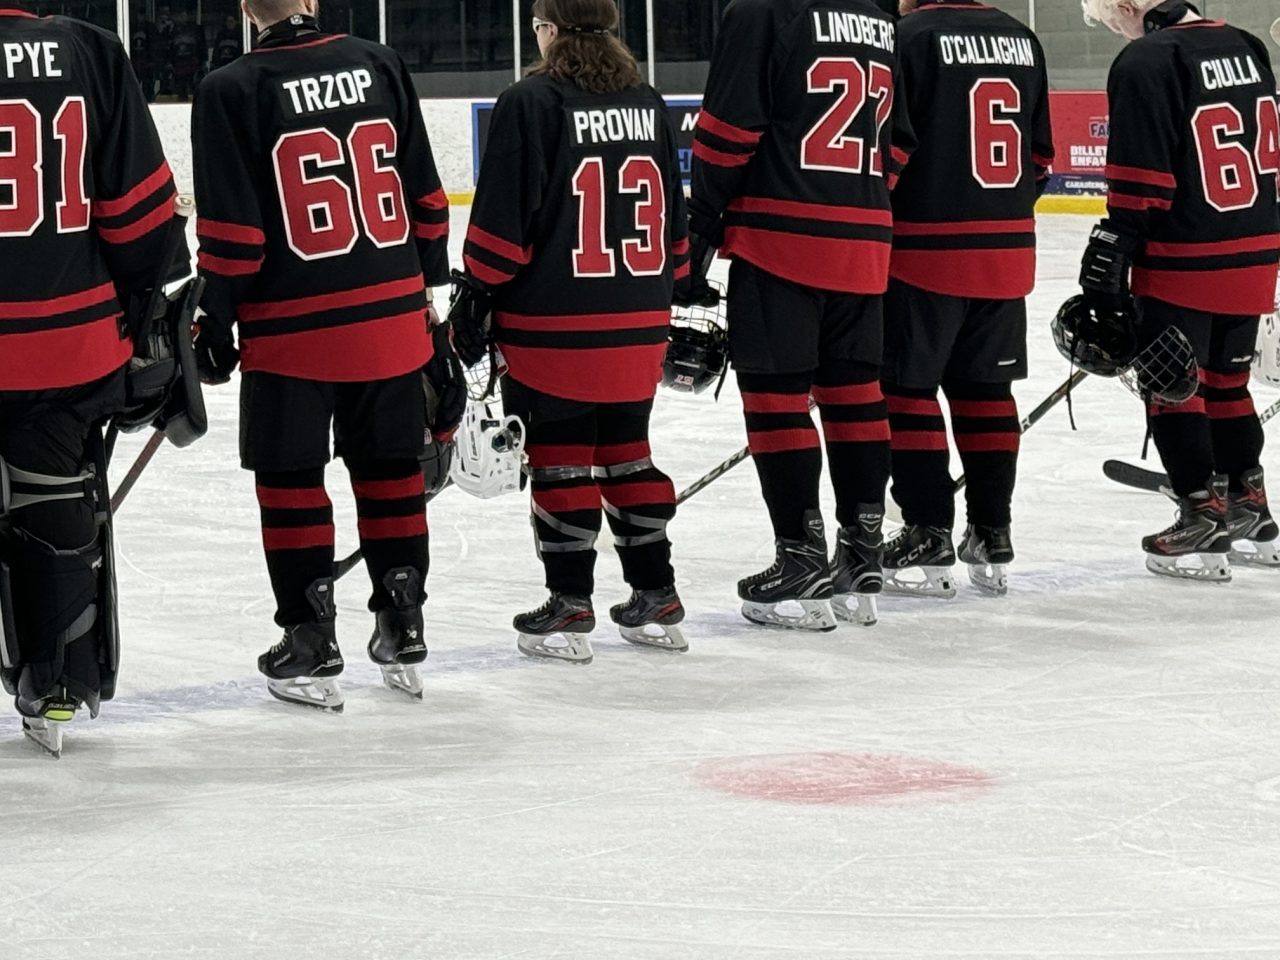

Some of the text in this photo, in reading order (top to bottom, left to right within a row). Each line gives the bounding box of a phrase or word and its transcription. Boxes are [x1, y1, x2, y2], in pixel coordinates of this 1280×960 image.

[2, 40, 63, 79] PYE
[940, 34, 1035, 68] O'CALLAGHAN
[1200, 54, 1262, 90] CIULLA
[282, 68, 373, 115] TRZOP
[573, 108, 655, 144] PROVAN
[800, 56, 894, 178] 27
[968, 77, 1022, 189] 6
[1190, 95, 1280, 213] 64
[271, 117, 410, 261] 66
[571, 154, 667, 278] 13
[896, 539, 932, 567] CCM
